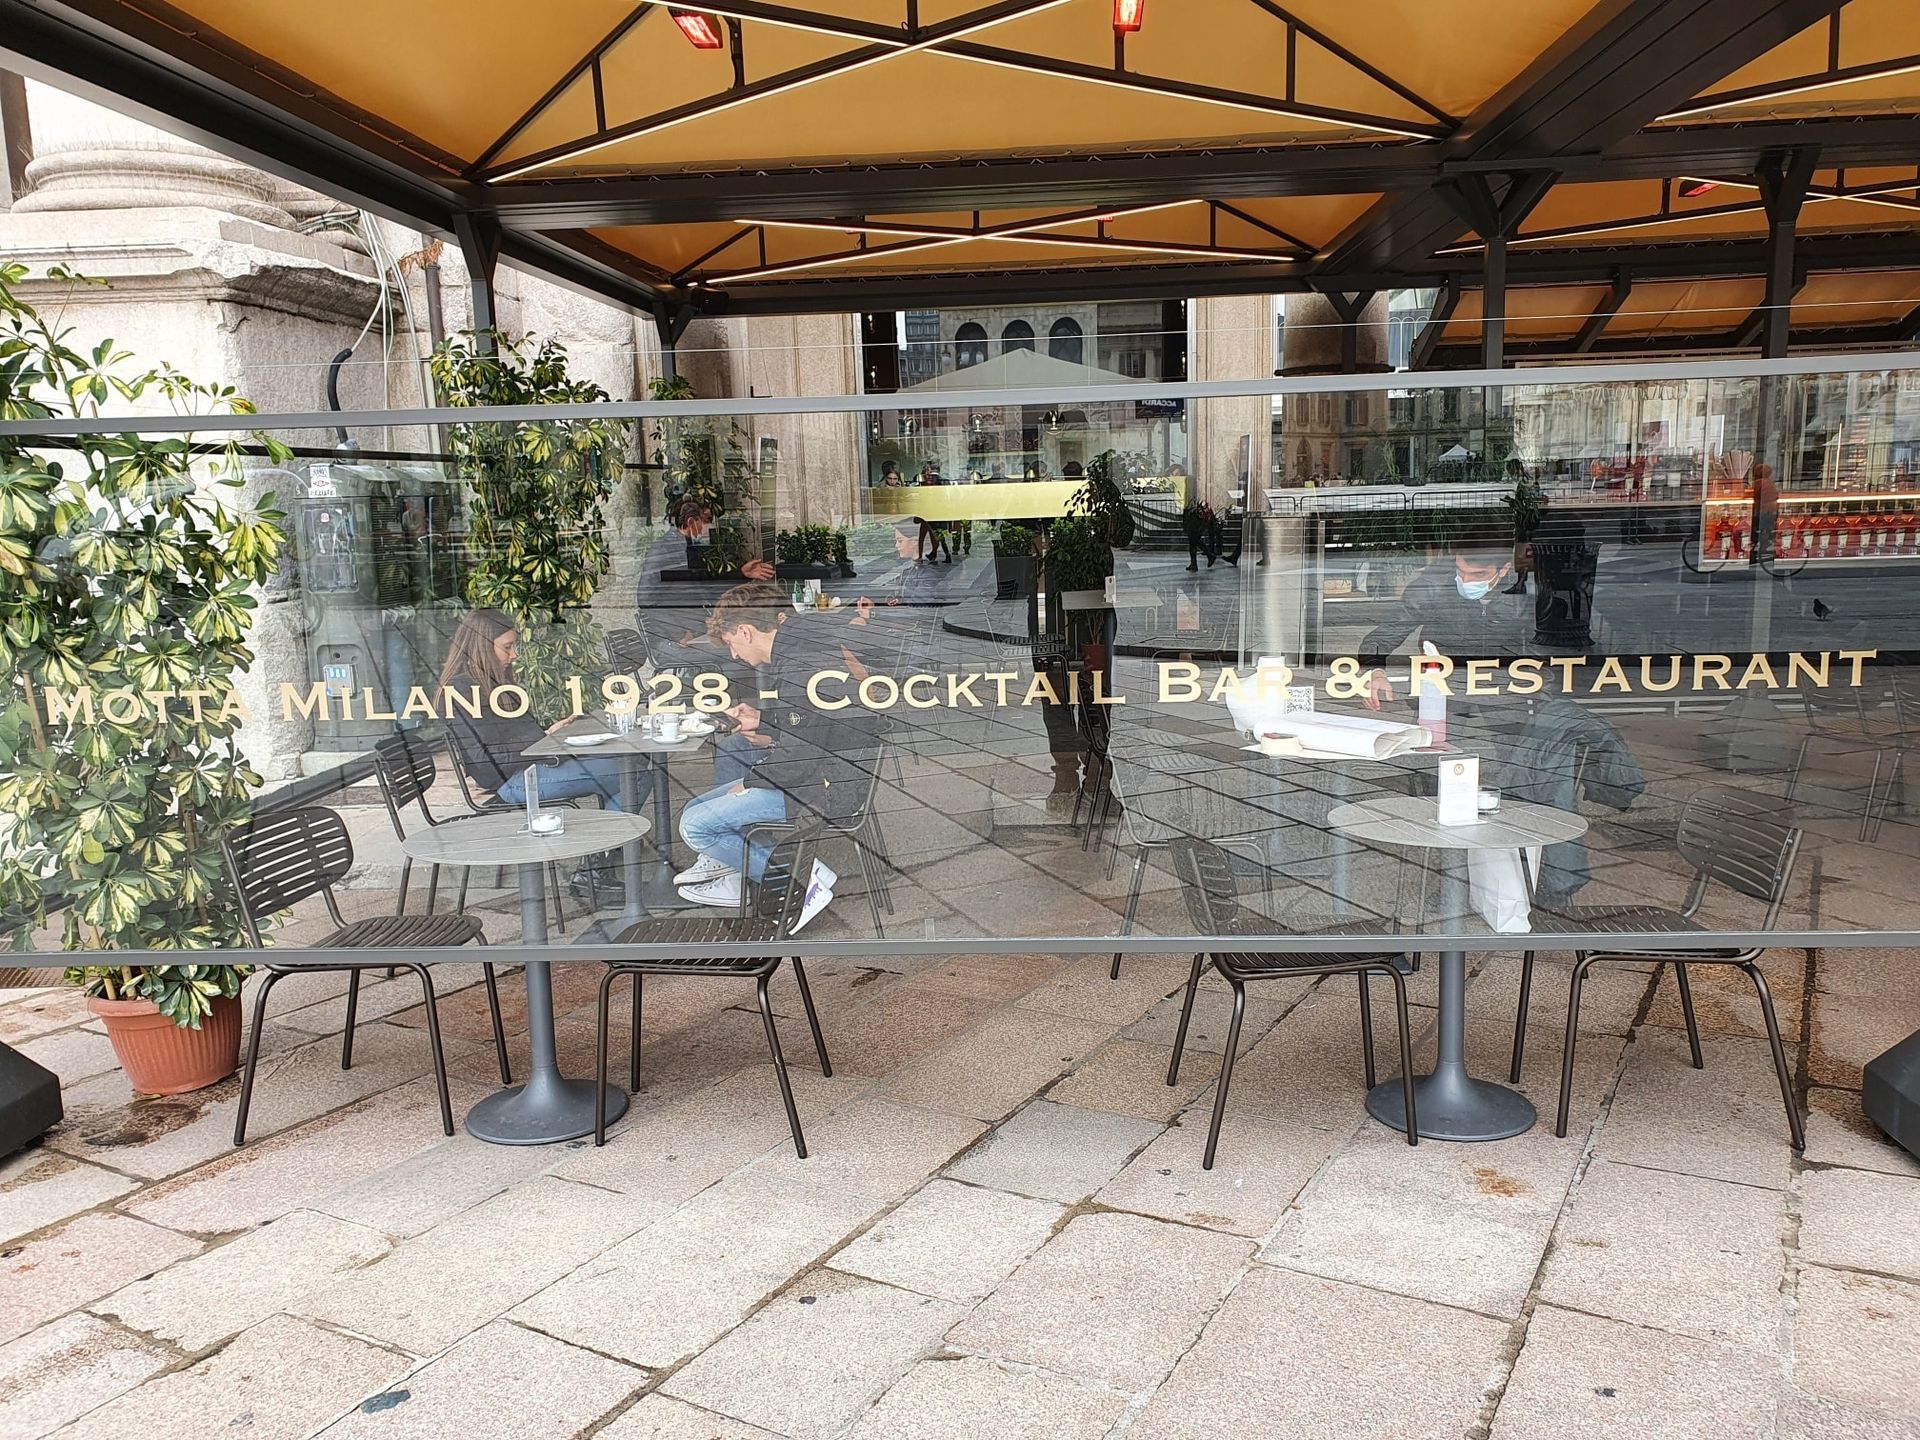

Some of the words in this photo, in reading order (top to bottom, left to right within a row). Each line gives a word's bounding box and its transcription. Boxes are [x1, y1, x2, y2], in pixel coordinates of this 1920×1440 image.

[44, 685, 255, 726] MOTTA
[282, 680, 530, 722] MILANO
[565, 672, 732, 716] 1928
[760, 688, 779, 700] -
[807, 669, 1126, 710] COCKTAIL
[1156, 661, 1294, 703] BAR
[1325, 656, 1374, 699] &
[1408, 648, 1877, 697] RESTAURANT
